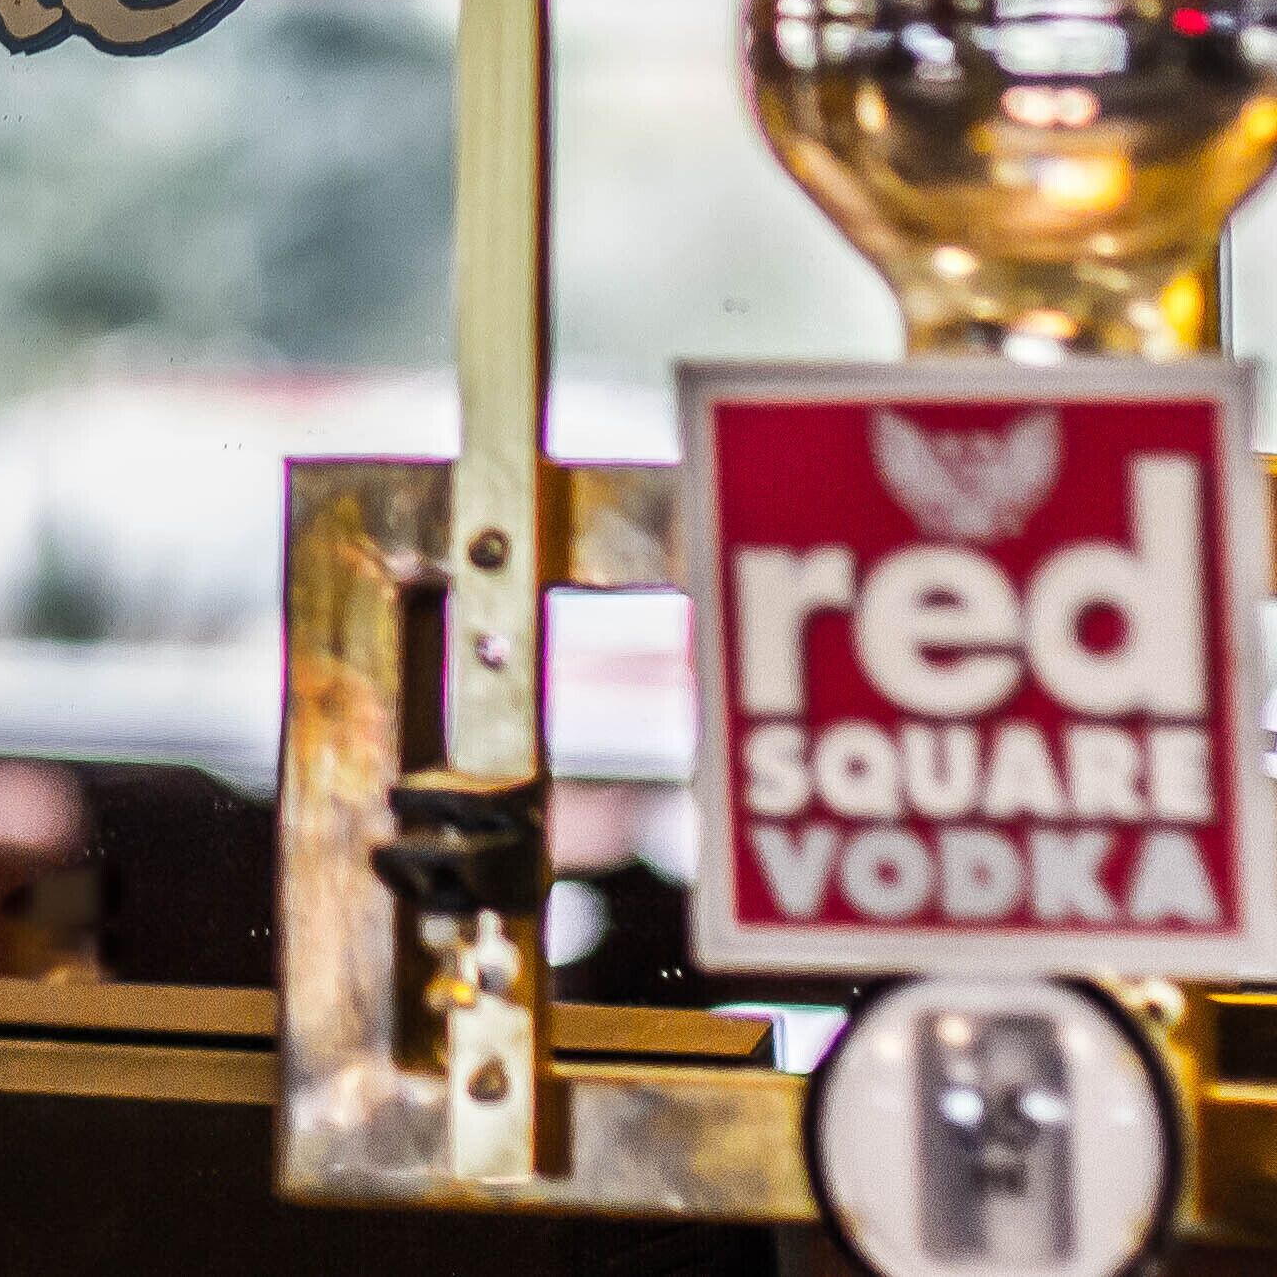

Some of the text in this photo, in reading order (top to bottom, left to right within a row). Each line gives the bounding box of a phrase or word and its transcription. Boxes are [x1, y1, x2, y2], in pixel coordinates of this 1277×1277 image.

[735, 454, 1207, 719] red
[745, 725, 1213, 820] SQUARE
[750, 824, 1221, 922] VODKA
